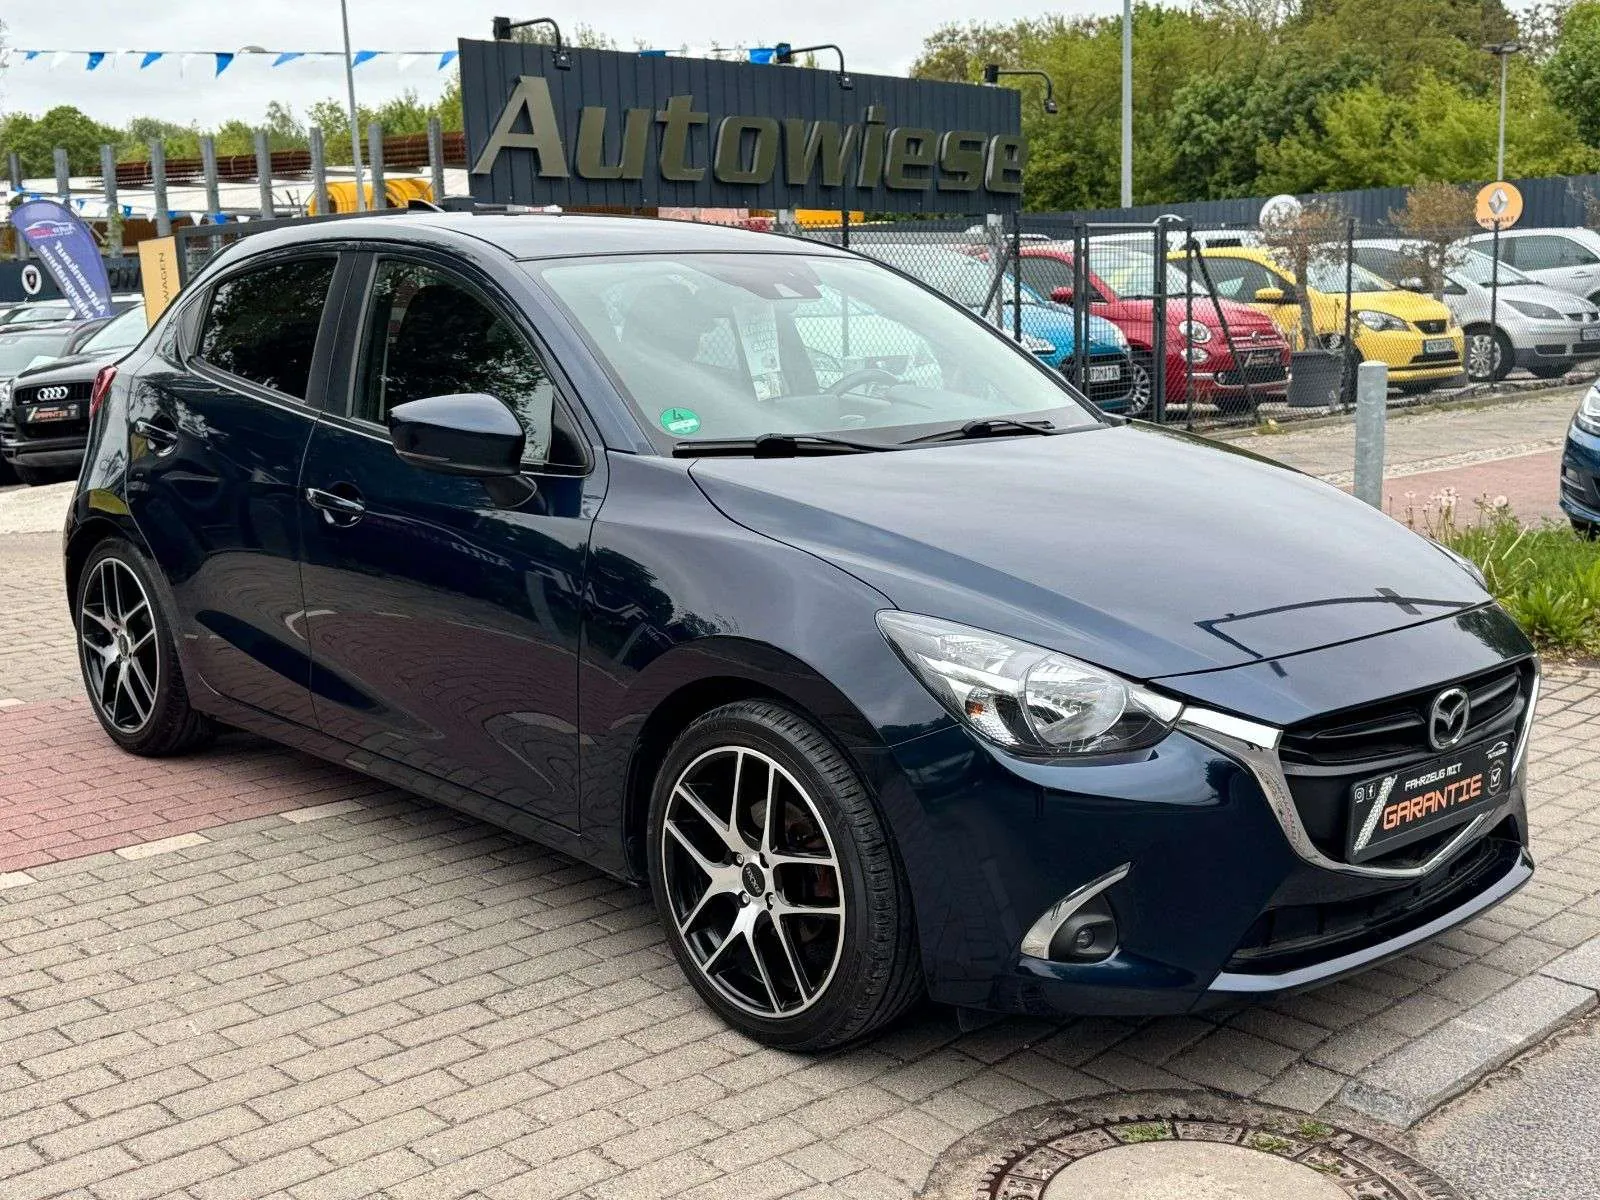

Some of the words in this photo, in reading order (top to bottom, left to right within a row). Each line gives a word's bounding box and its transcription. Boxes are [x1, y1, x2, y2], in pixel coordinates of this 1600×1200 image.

[472, 75, 1024, 194] Autowiese
[1383, 773, 1482, 830] GARANTIE
[1404, 768, 1446, 791] FAHRZEUG
[1446, 763, 1463, 776] MIT
